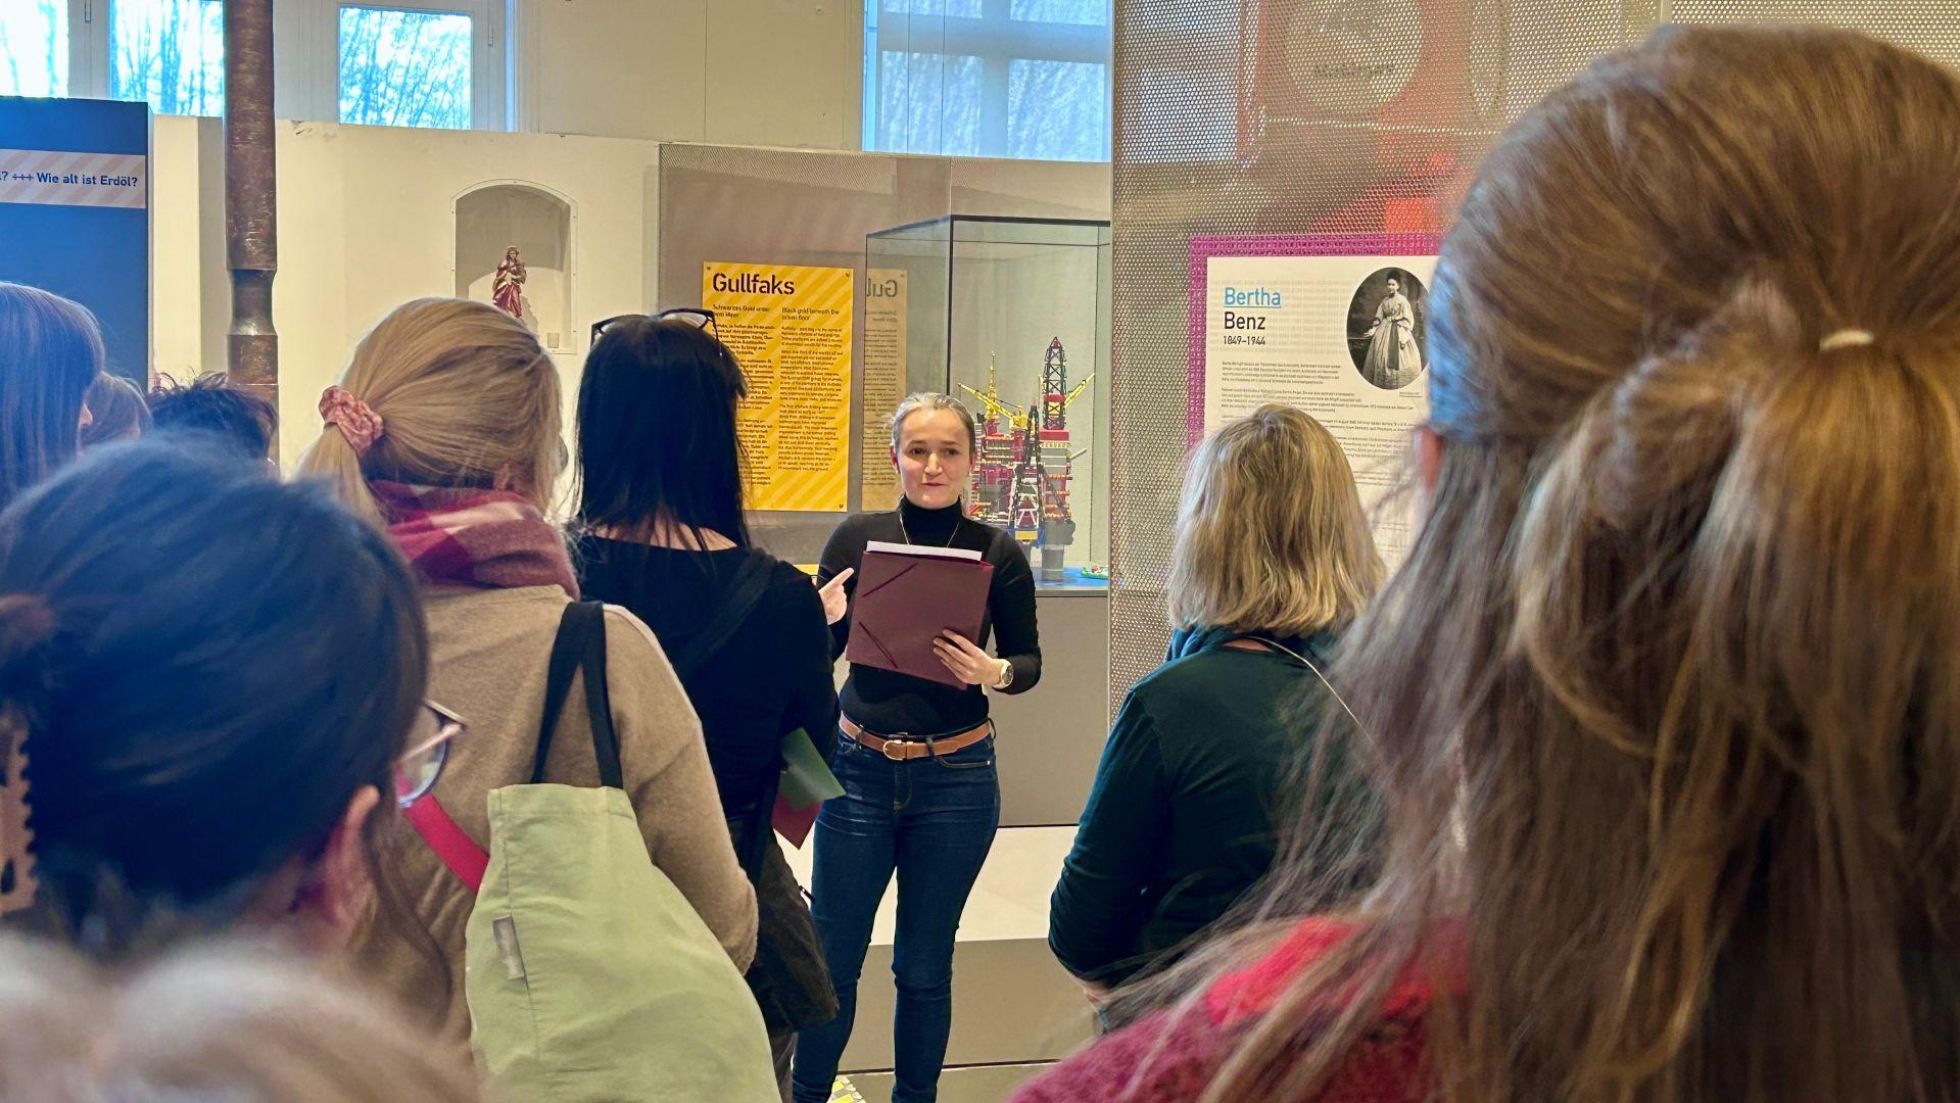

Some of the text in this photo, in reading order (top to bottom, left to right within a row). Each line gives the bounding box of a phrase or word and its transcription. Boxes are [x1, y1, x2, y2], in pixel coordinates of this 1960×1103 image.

[36, 172, 59, 184] Wie
[62, 173, 78, 185] alt
[82, 174, 97, 186] ist
[100, 175, 138, 188] Erdöl?
[712, 272, 796, 295] Gullfaks
[1224, 287, 1282, 307] Bertha
[1224, 311, 1267, 331] Benz
